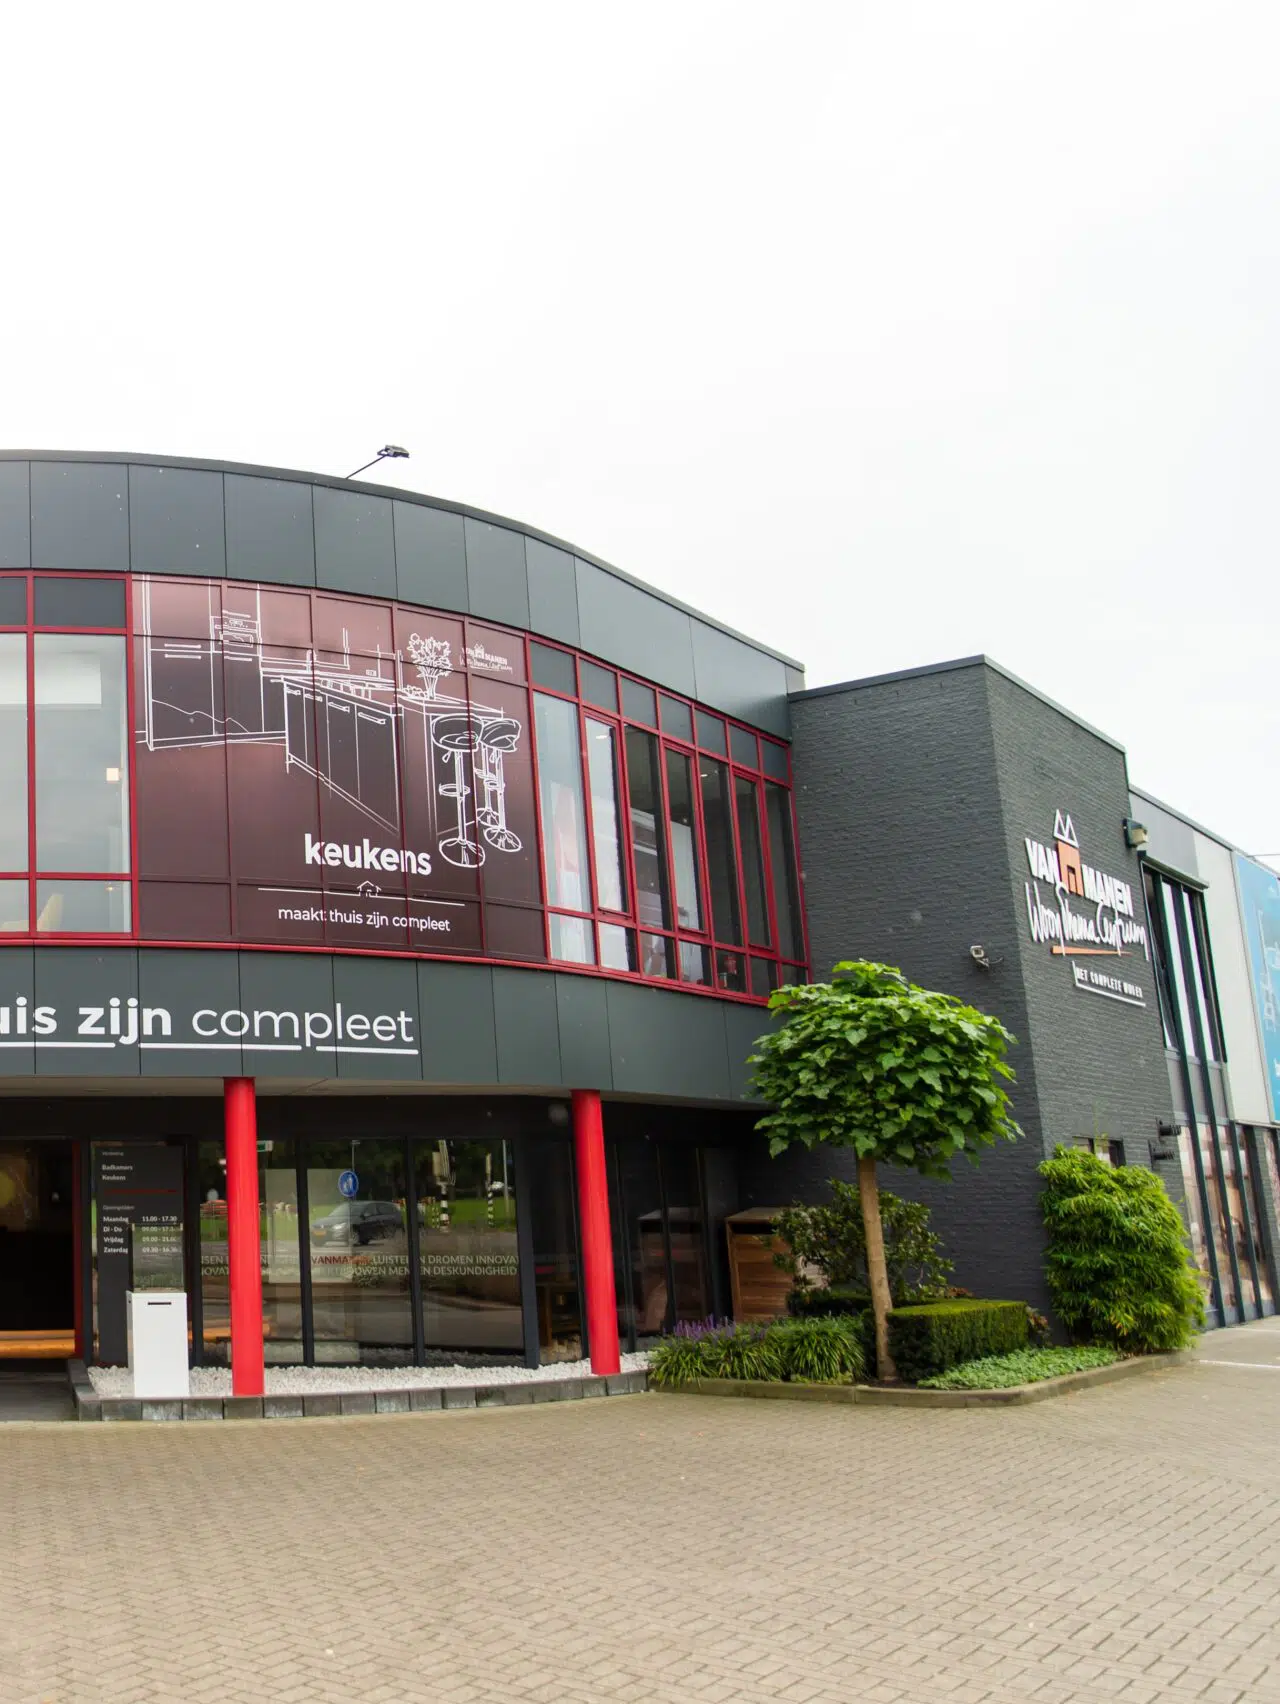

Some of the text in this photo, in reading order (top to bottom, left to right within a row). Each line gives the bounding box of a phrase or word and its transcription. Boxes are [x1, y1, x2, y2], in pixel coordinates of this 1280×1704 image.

[304, 833, 432, 876] keukens
[1024, 837, 1134, 917] VAN MANEN
[278, 907, 451, 931] maakt thuis zijn compleet
[1090, 971, 1122, 992] COMPLETE
[77, 997, 172, 1045] zijn
[191, 1002, 415, 1047] compleet
[103, 1216, 129, 1224] Maandag
[428, 1255, 475, 1264] DROMEN
[433, 1266, 518, 1275] DESKUNDIGHEID
